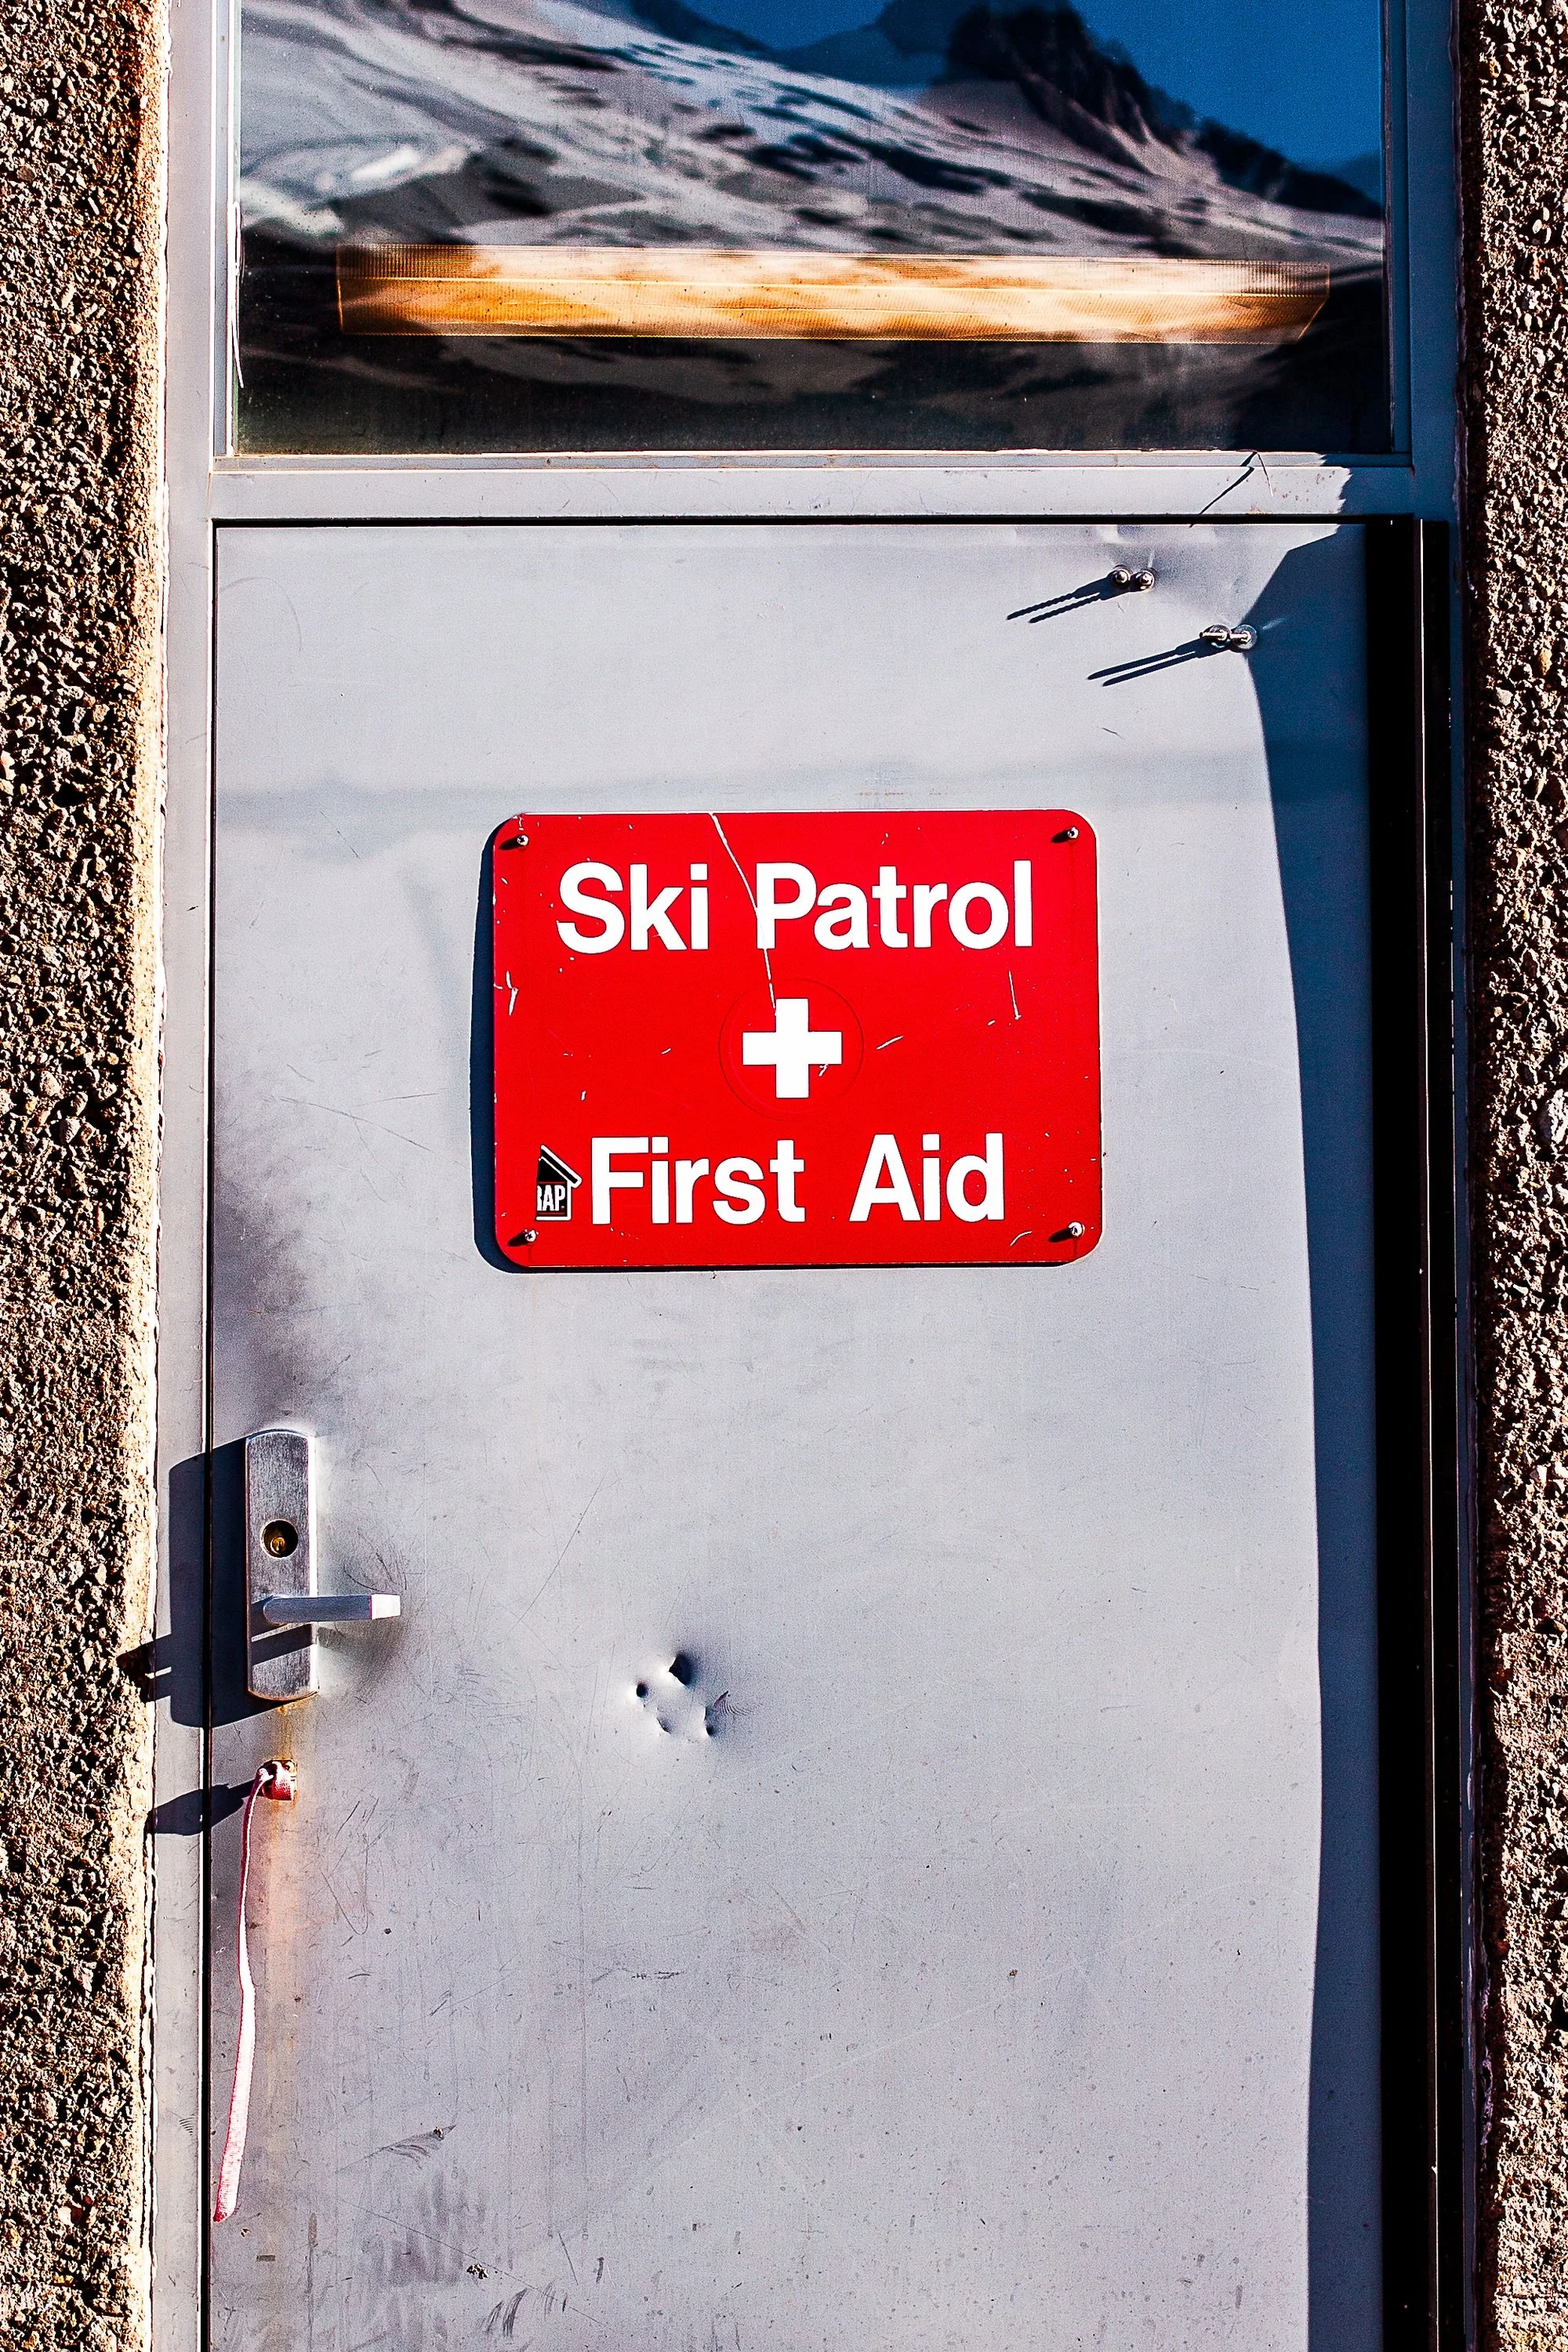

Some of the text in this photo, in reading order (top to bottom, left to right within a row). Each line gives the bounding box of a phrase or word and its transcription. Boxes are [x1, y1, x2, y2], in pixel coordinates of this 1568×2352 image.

[557, 860, 1033, 953] Ski Patrol
[591, 1133, 1004, 1225] First Aid
